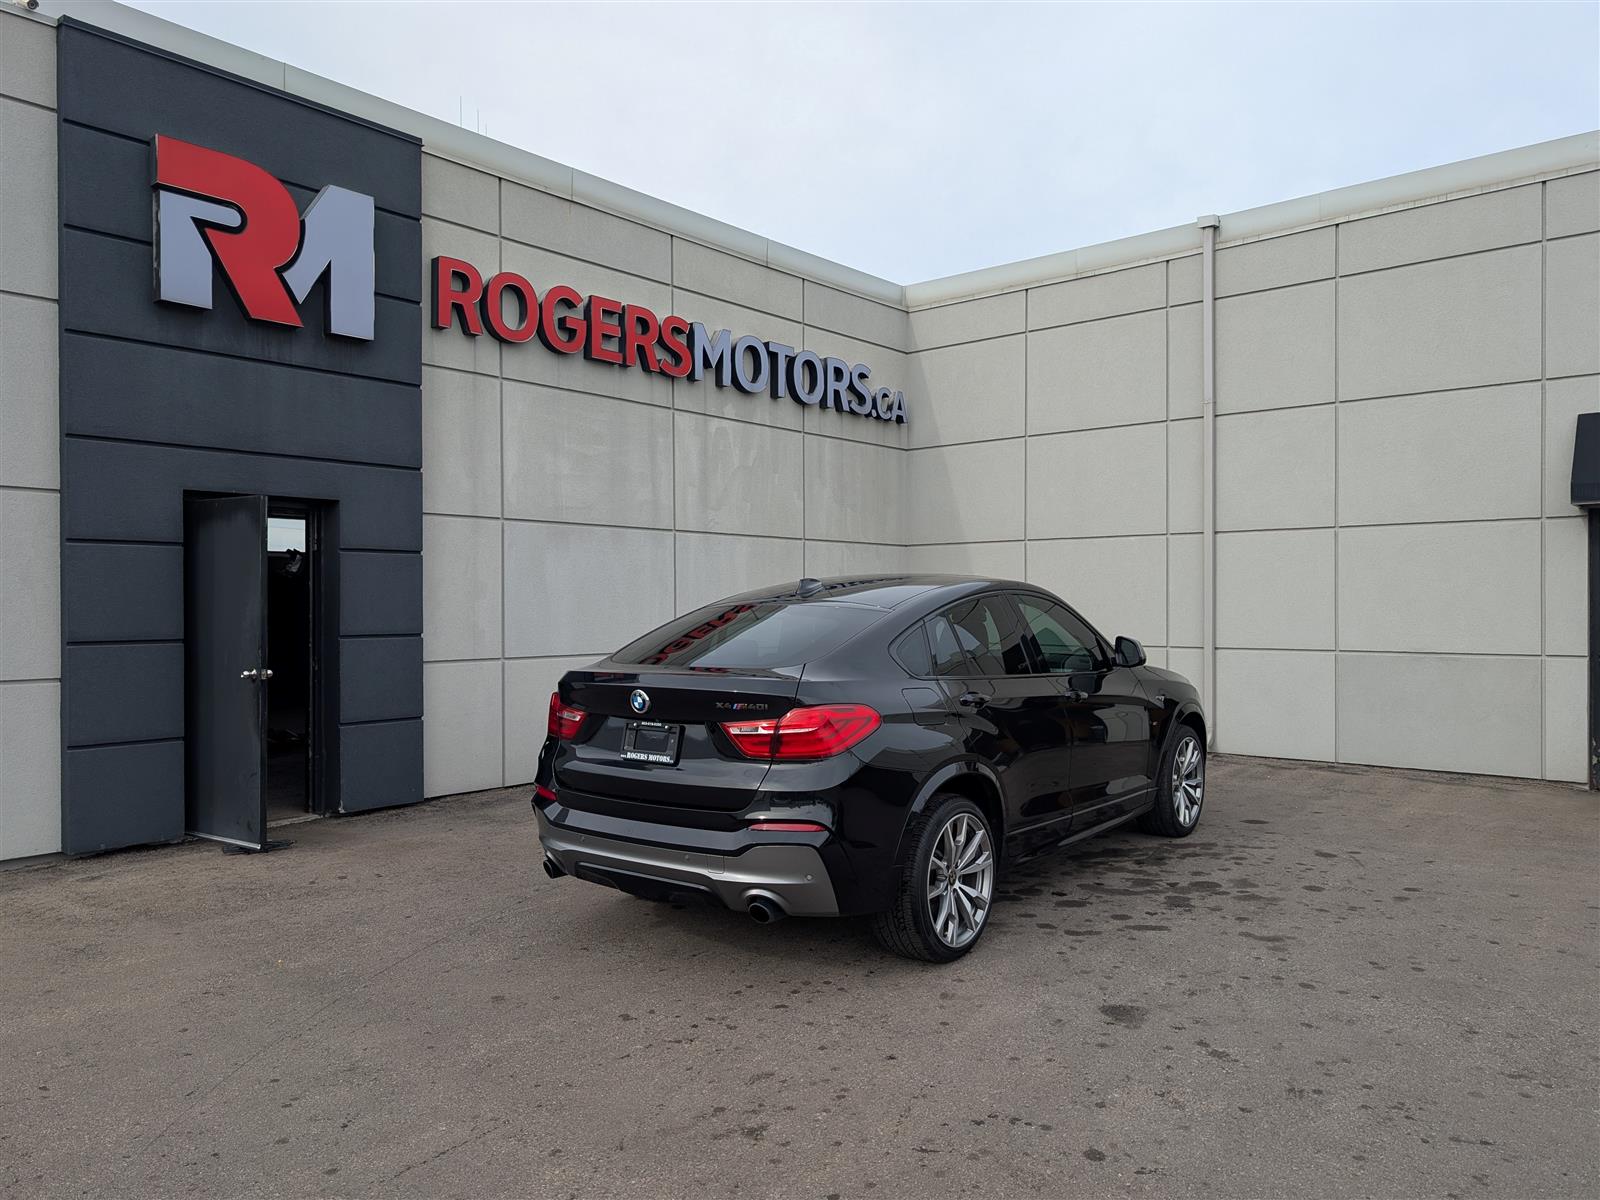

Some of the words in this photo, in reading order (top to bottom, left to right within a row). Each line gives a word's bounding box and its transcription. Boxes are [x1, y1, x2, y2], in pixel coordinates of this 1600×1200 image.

[152, 133, 376, 341] RM
[626, 751, 648, 761] ROGERS
[648, 753, 671, 763] MOTORS
